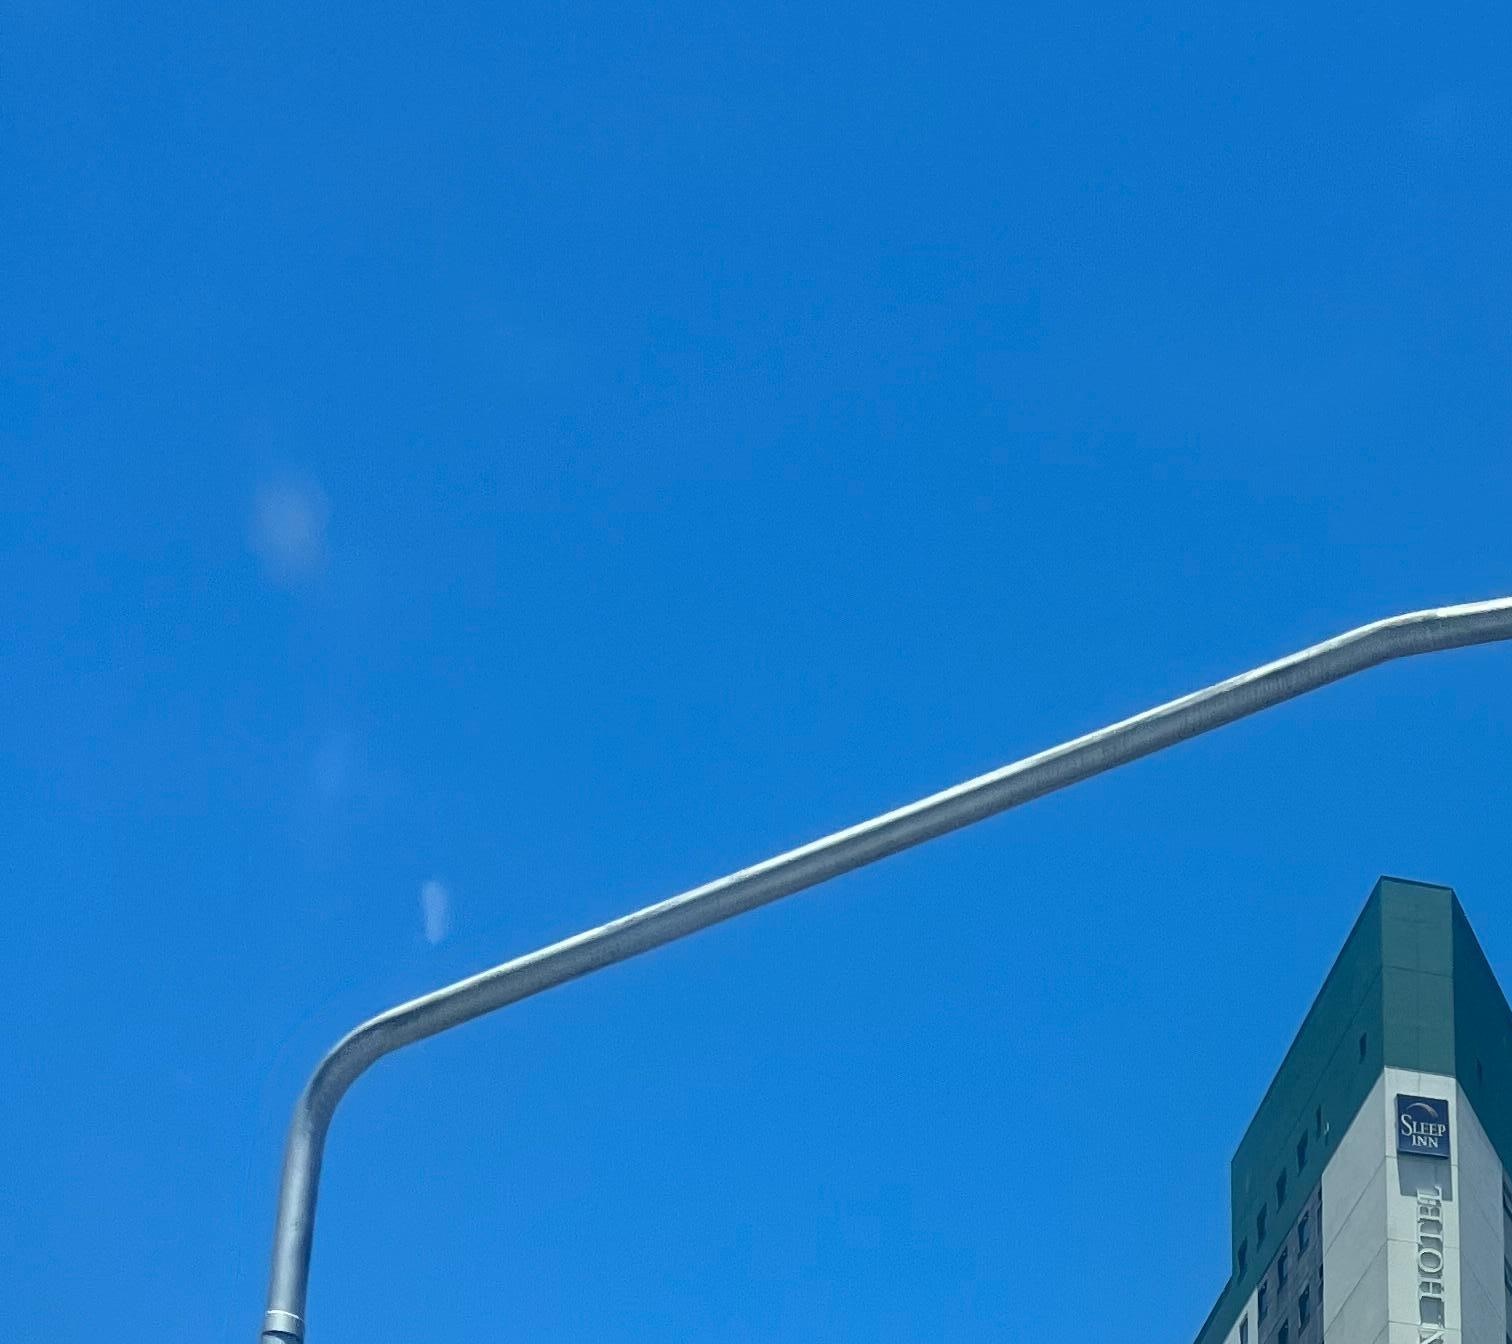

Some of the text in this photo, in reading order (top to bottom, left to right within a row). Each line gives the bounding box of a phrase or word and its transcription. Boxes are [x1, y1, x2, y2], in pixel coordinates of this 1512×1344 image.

[1401, 1113, 1446, 1137] SLEEP
[1412, 1134, 1439, 1148] INN
[1417, 1185, 1445, 1302] HOTEL
